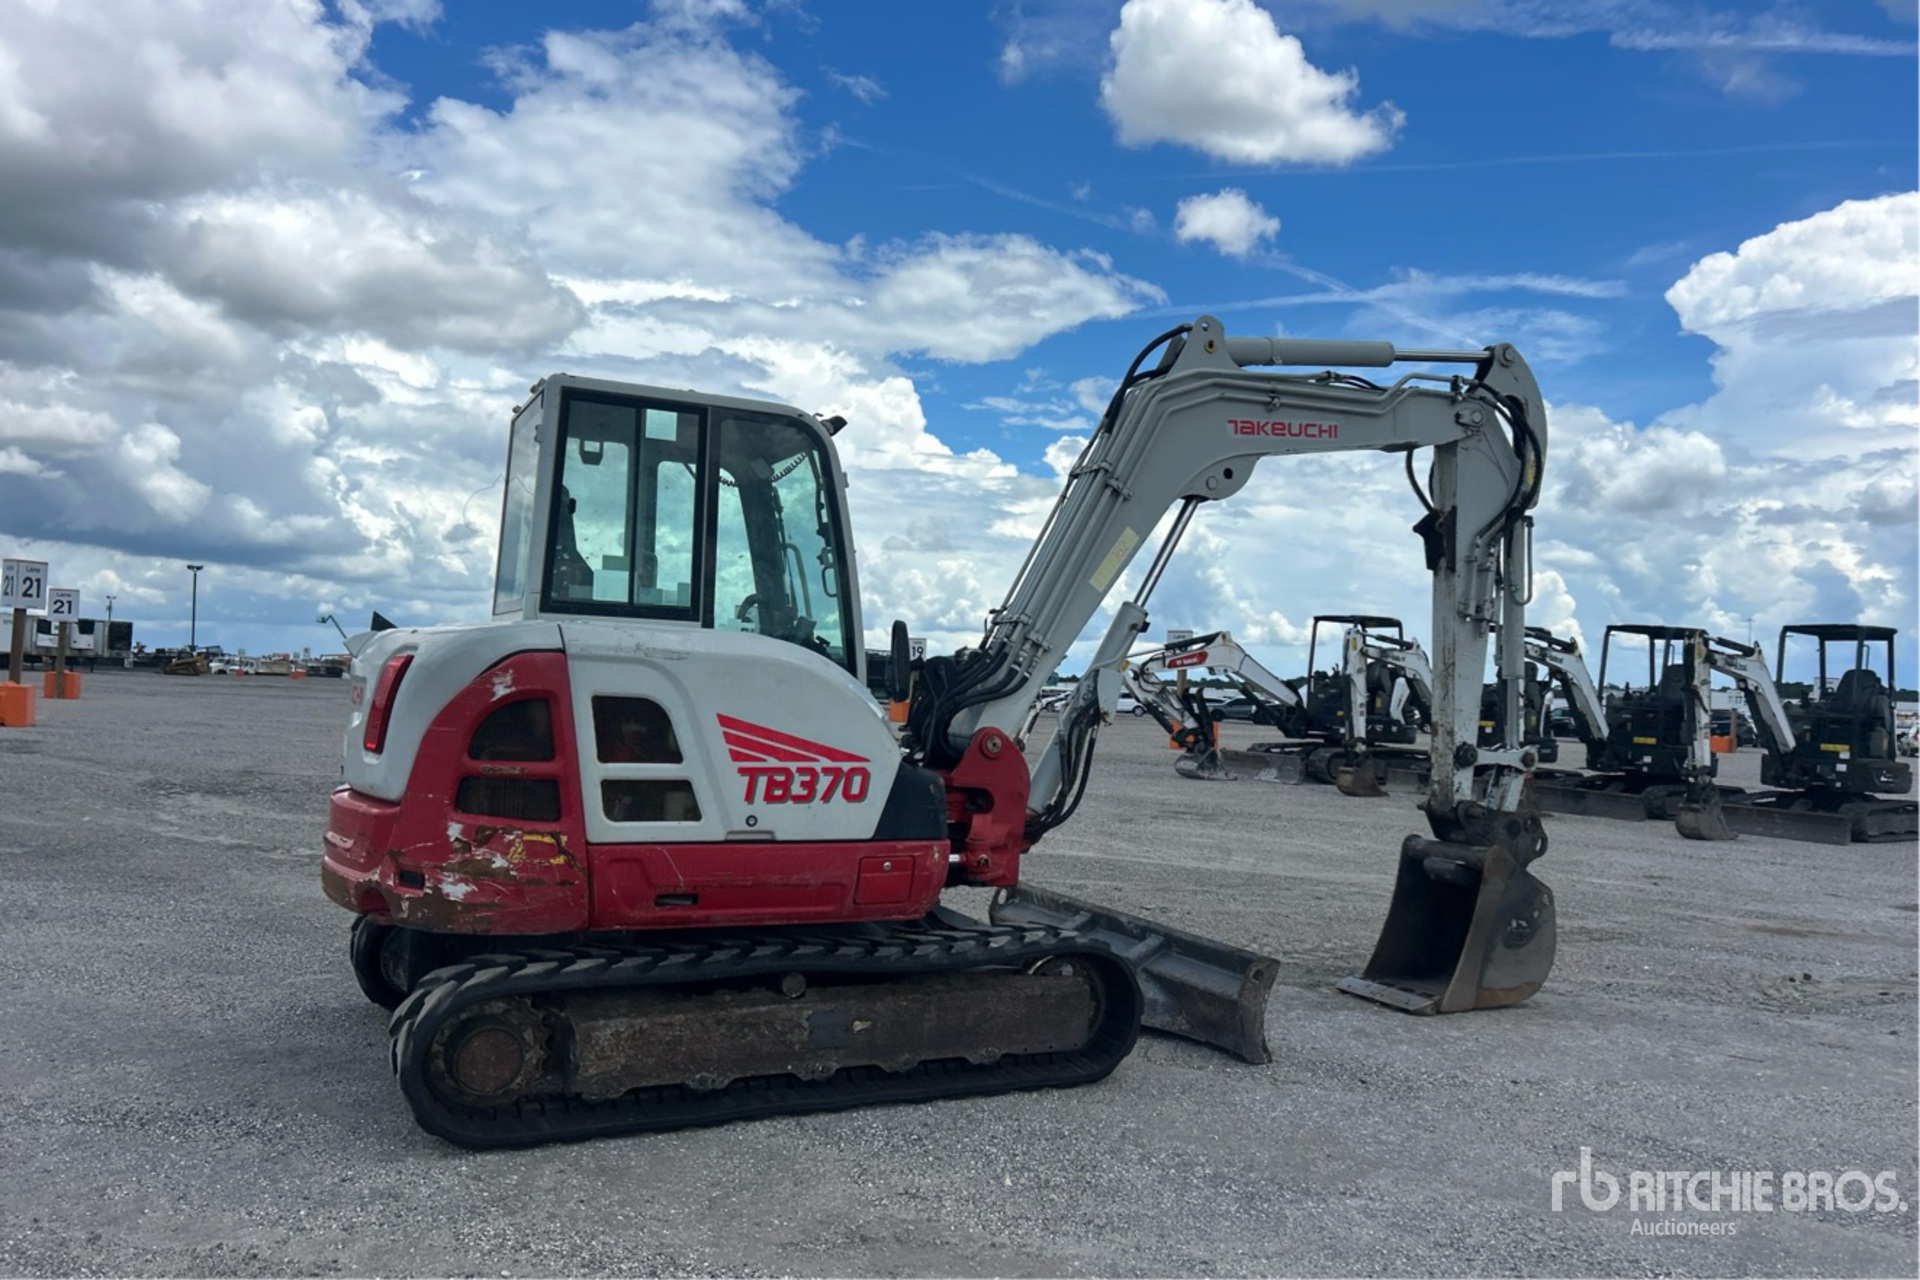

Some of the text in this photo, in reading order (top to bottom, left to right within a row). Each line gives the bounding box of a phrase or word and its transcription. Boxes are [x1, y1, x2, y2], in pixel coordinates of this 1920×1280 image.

[1227, 419, 1338, 439] TAKEUCHI
[4, 575, 14, 597] 21
[22, 576, 41, 599] 21
[53, 599, 72, 614] 21
[737, 766, 871, 804] TB370
